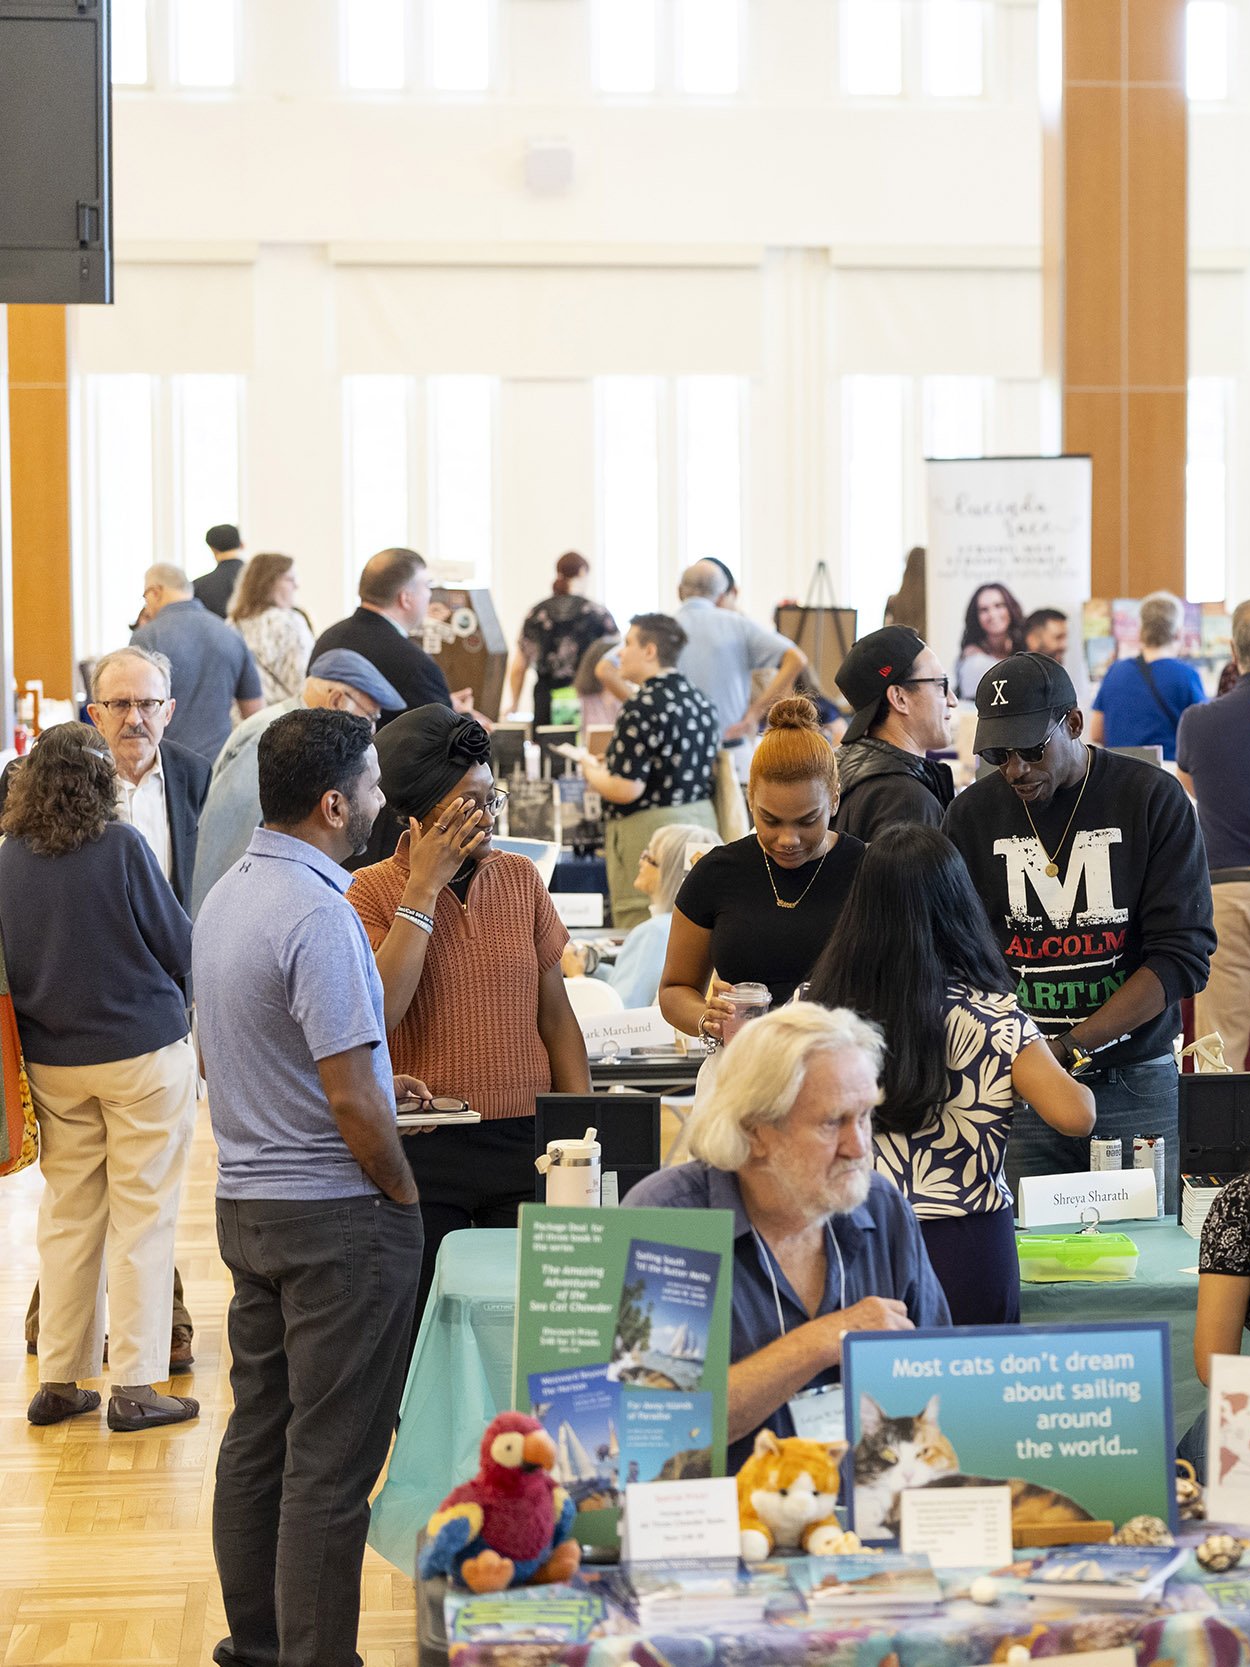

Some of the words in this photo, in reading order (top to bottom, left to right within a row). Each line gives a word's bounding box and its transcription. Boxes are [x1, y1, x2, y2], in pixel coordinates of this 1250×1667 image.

[990, 680, 1009, 706] X
[993, 828, 1129, 931] M
[1005, 929, 1126, 959] ALCOLM
[583, 1027, 600, 1039] ark
[602, 1021, 652, 1038] Marchand
[1053, 1192, 1086, 1208] Shreya
[1088, 1188, 1129, 1204] Sharath
[533, 1221, 566, 1233] Package
[569, 1222, 587, 1233] Deal
[590, 1222, 604, 1233] for
[532, 1242, 547, 1252] the
[549, 1243, 575, 1252] series
[545, 1233, 568, 1243] three
[635, 1250, 662, 1265] Sailing
[663, 1255, 686, 1268] South
[541, 1264, 560, 1276] The
[561, 1265, 605, 1279] Amazing
[648, 1263, 661, 1275] the
[662, 1266, 688, 1279] Butter
[543, 1278, 600, 1289] Adventures
[555, 1290, 567, 1302] of
[569, 1290, 587, 1301] the
[529, 1301, 547, 1312] Sea
[549, 1301, 567, 1312] Cat
[569, 1301, 613, 1313] Chowder
[542, 1327, 575, 1337] Discount
[577, 1328, 599, 1338] Price
[892, 1358, 943, 1379] Most
[949, 1356, 995, 1376] cats
[1000, 1352, 1059, 1375] don't
[1065, 1350, 1135, 1373] dream
[1002, 1381, 1066, 1403] about
[1071, 1377, 1141, 1403] sailing
[1036, 1406, 1112, 1430] around
[1016, 1437, 1053, 1460] the
[1058, 1434, 1138, 1457] world...
